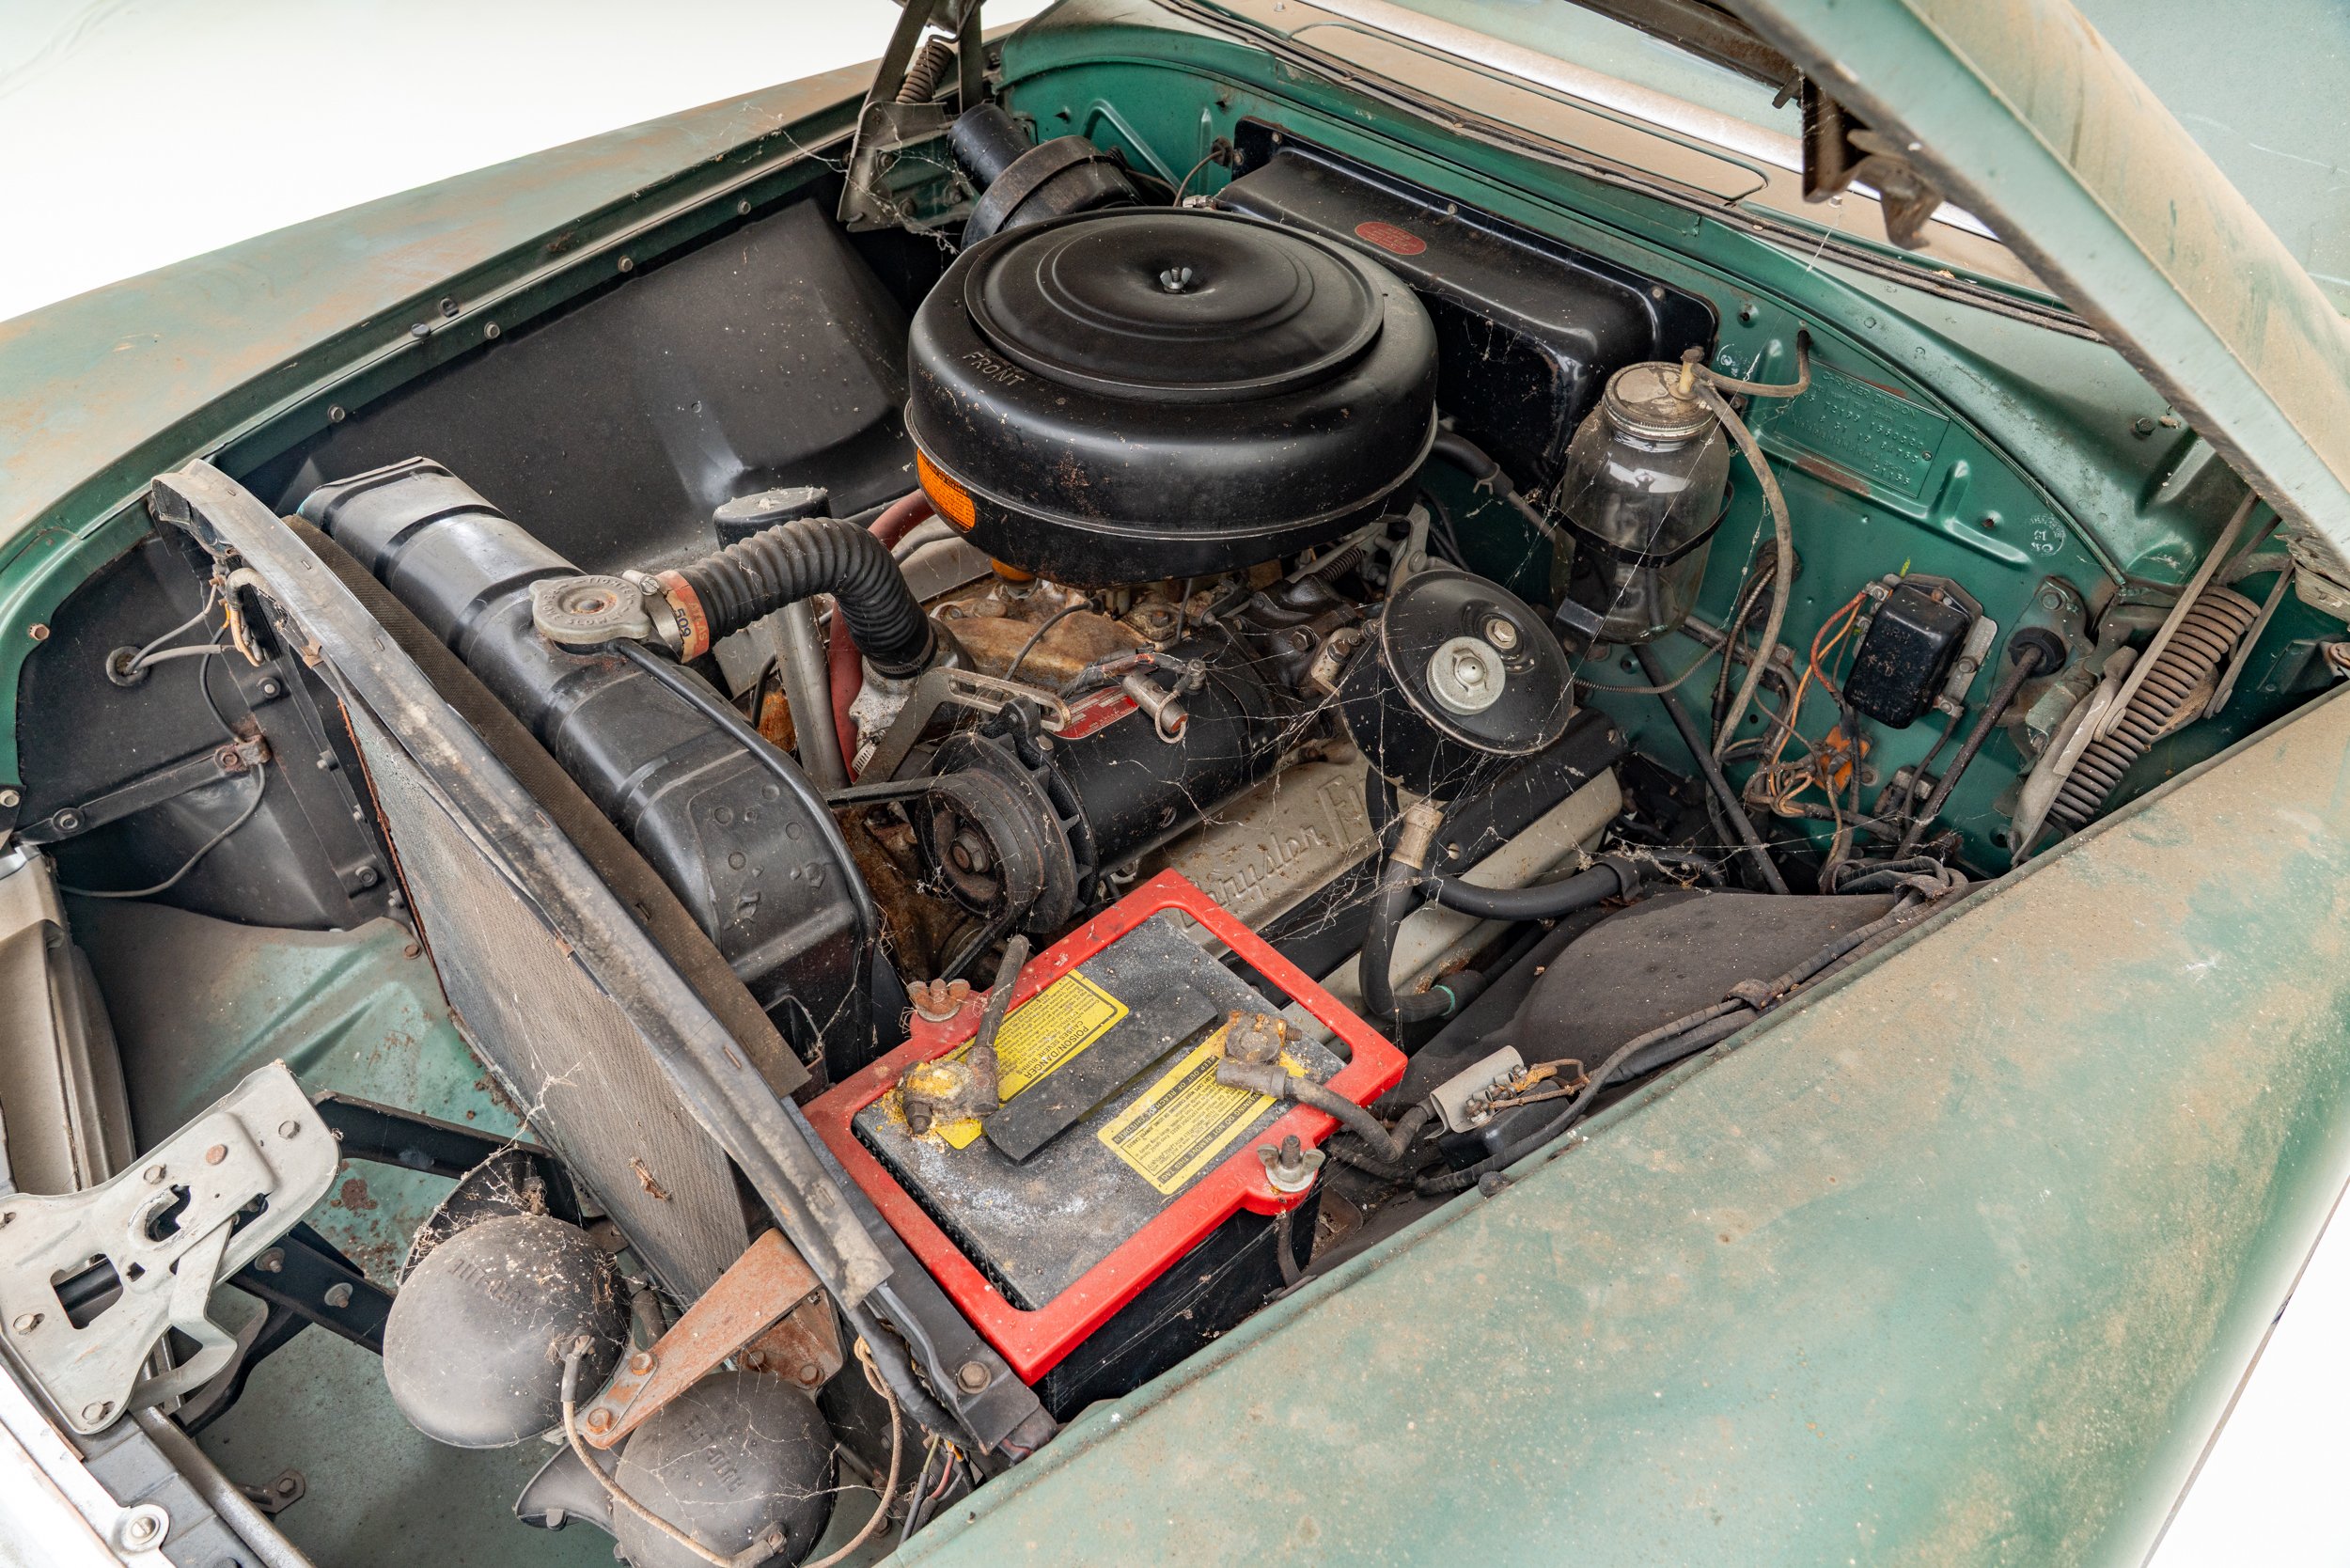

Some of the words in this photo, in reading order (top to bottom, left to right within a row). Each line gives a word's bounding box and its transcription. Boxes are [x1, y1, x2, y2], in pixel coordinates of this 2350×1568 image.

[962, 351, 1026, 386] FRONT
[588, 576, 635, 599] TIGHTEN
[676, 607, 692, 637] 509
[1058, 1019, 1083, 1041] CAUSES
[1023, 1025, 1089, 1079] POISON/DANGER
[1036, 1038, 1059, 1058] SEVERE
[1015, 1057, 1037, 1075] BURNS
[1184, 1069, 1201, 1083] OUT
[1153, 1089, 1178, 1110] REACH
[1232, 1091, 1261, 1117] WARNING
[1112, 1115, 1146, 1144] CHILDREN
[1211, 1122, 1226, 1136] NOT
[1224, 1114, 1235, 1124] DO
[1186, 1134, 1214, 1158] REMOVE
[1172, 1154, 1189, 1169] THIS
